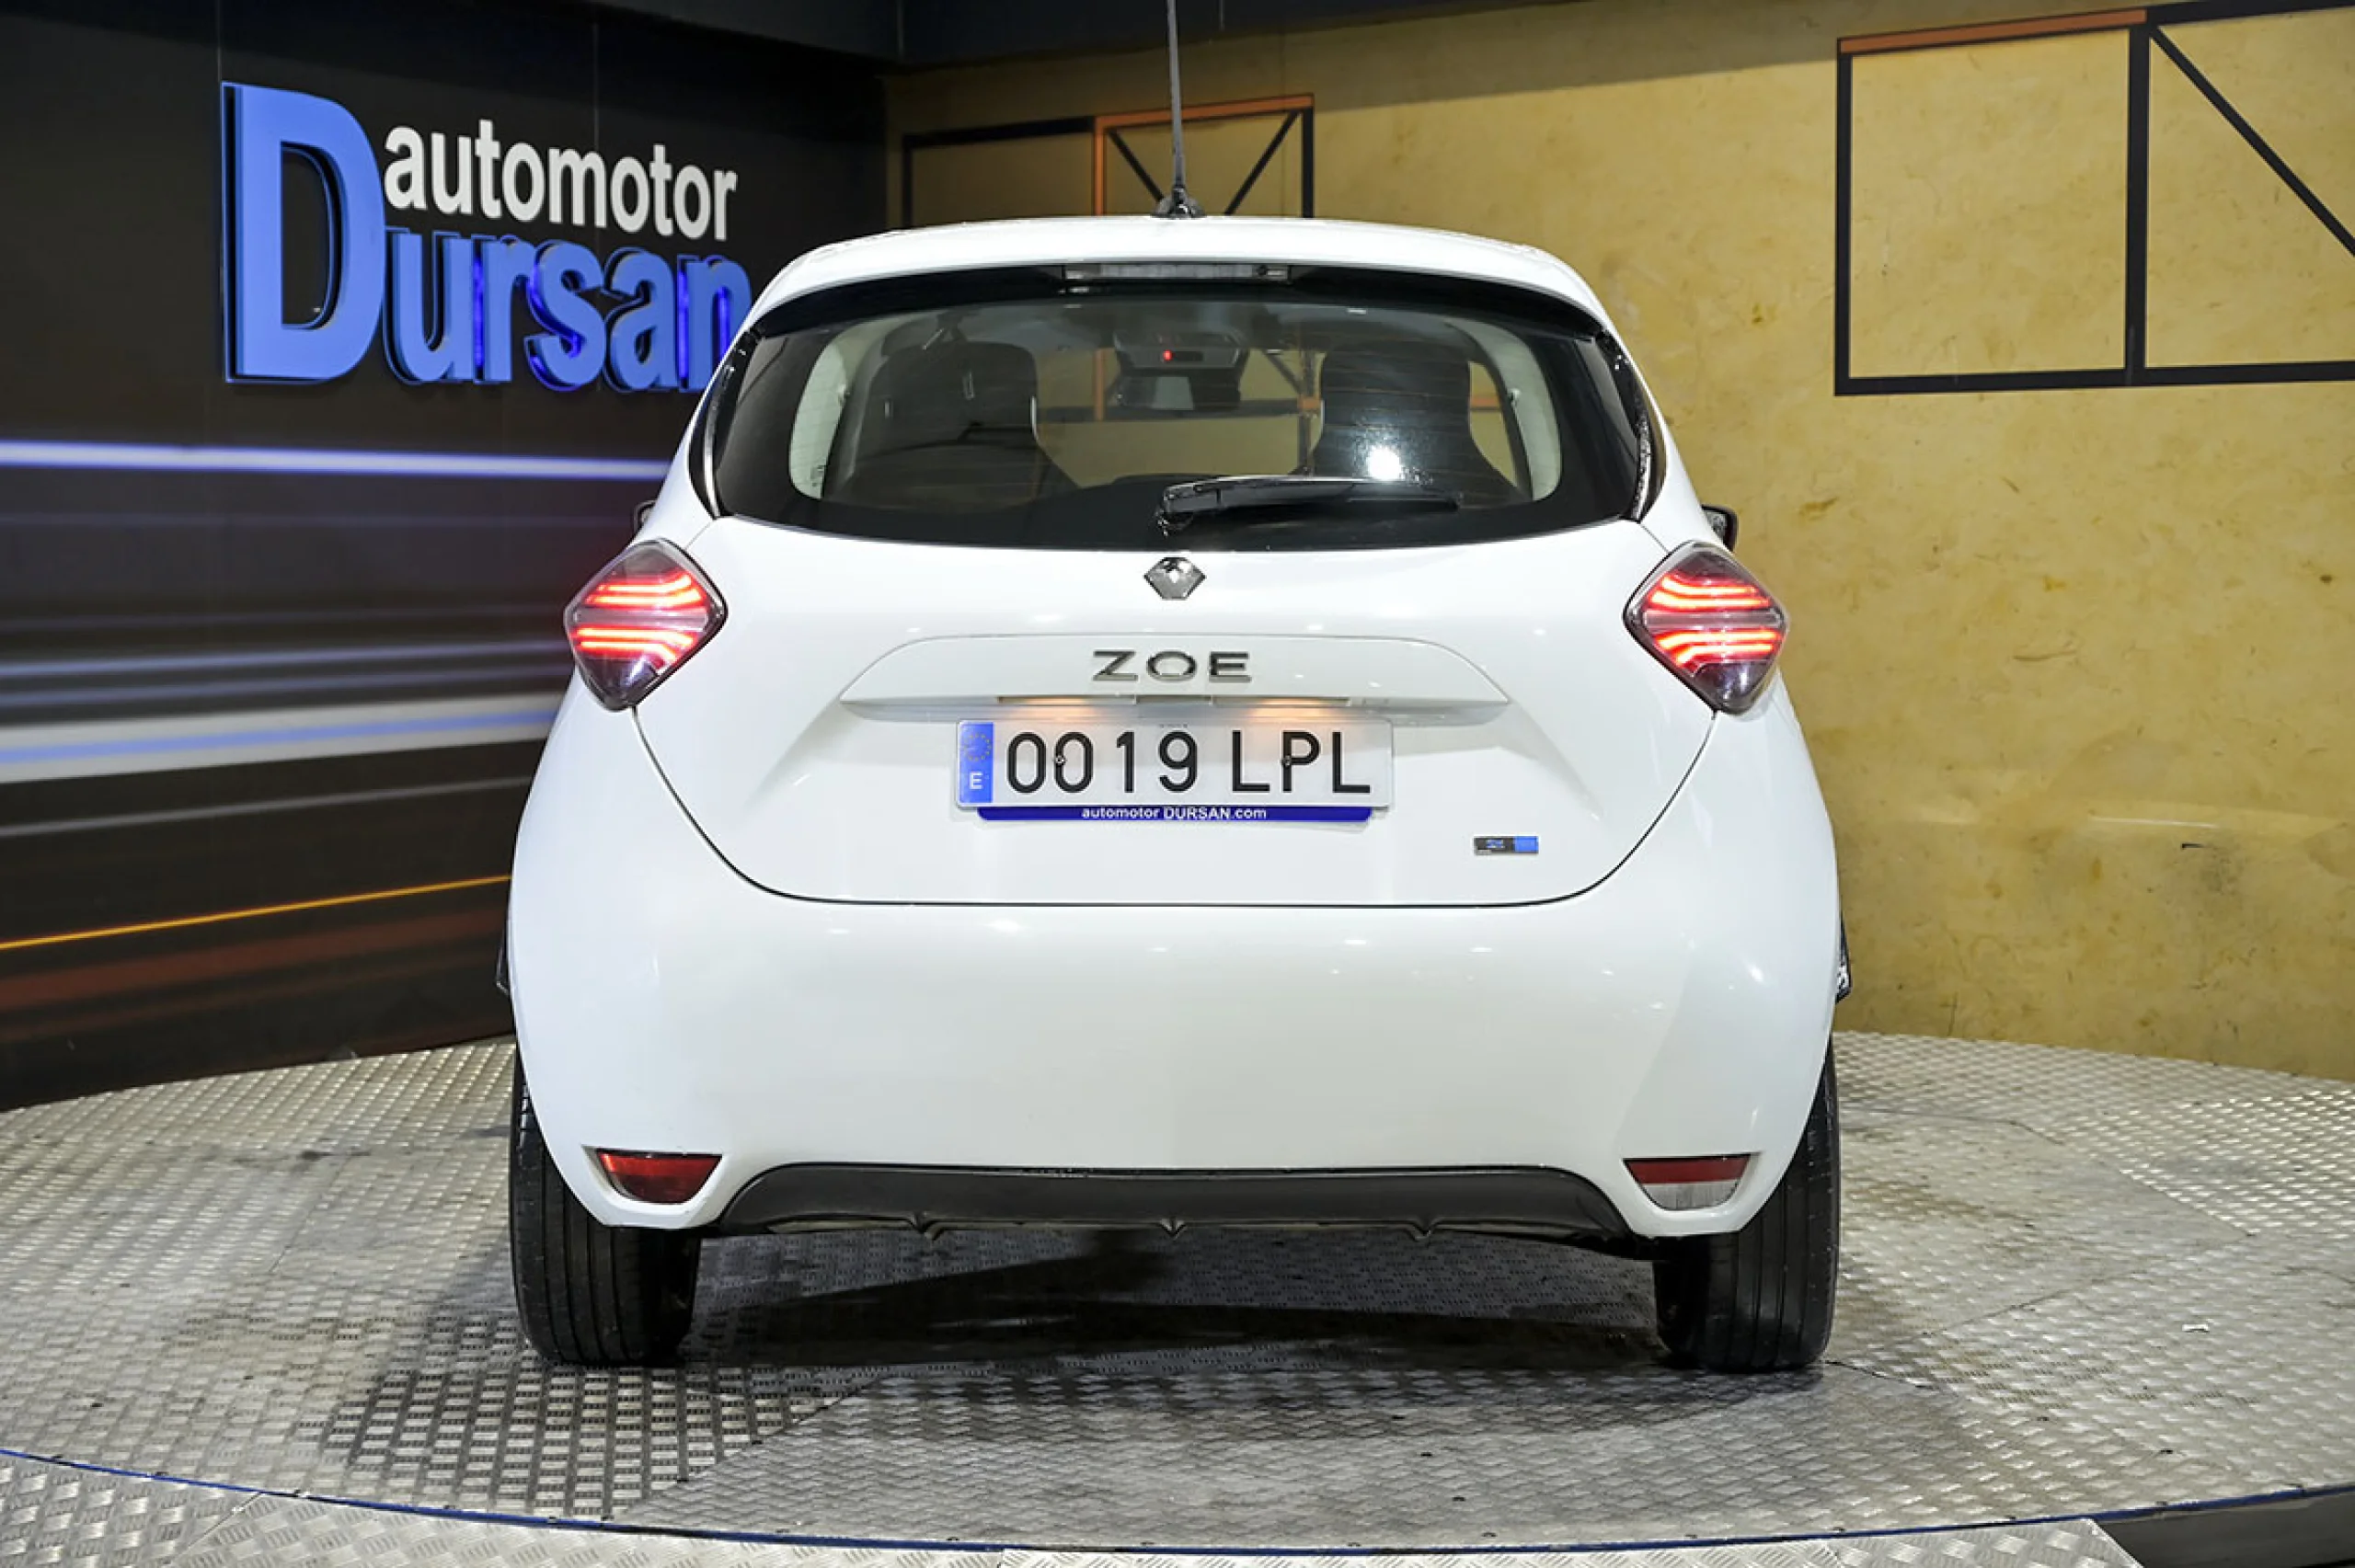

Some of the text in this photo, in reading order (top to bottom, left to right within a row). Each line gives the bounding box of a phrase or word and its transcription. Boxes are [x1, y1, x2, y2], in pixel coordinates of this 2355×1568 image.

[384, 119, 738, 241] automotor
[222, 81, 752, 393] Dursan
[1092, 650, 1252, 681] ZOE
[969, 772, 983, 790] E
[1006, 730, 1371, 794] 0019 LPL
[1081, 807, 1267, 820] automotor DURSAN.com
